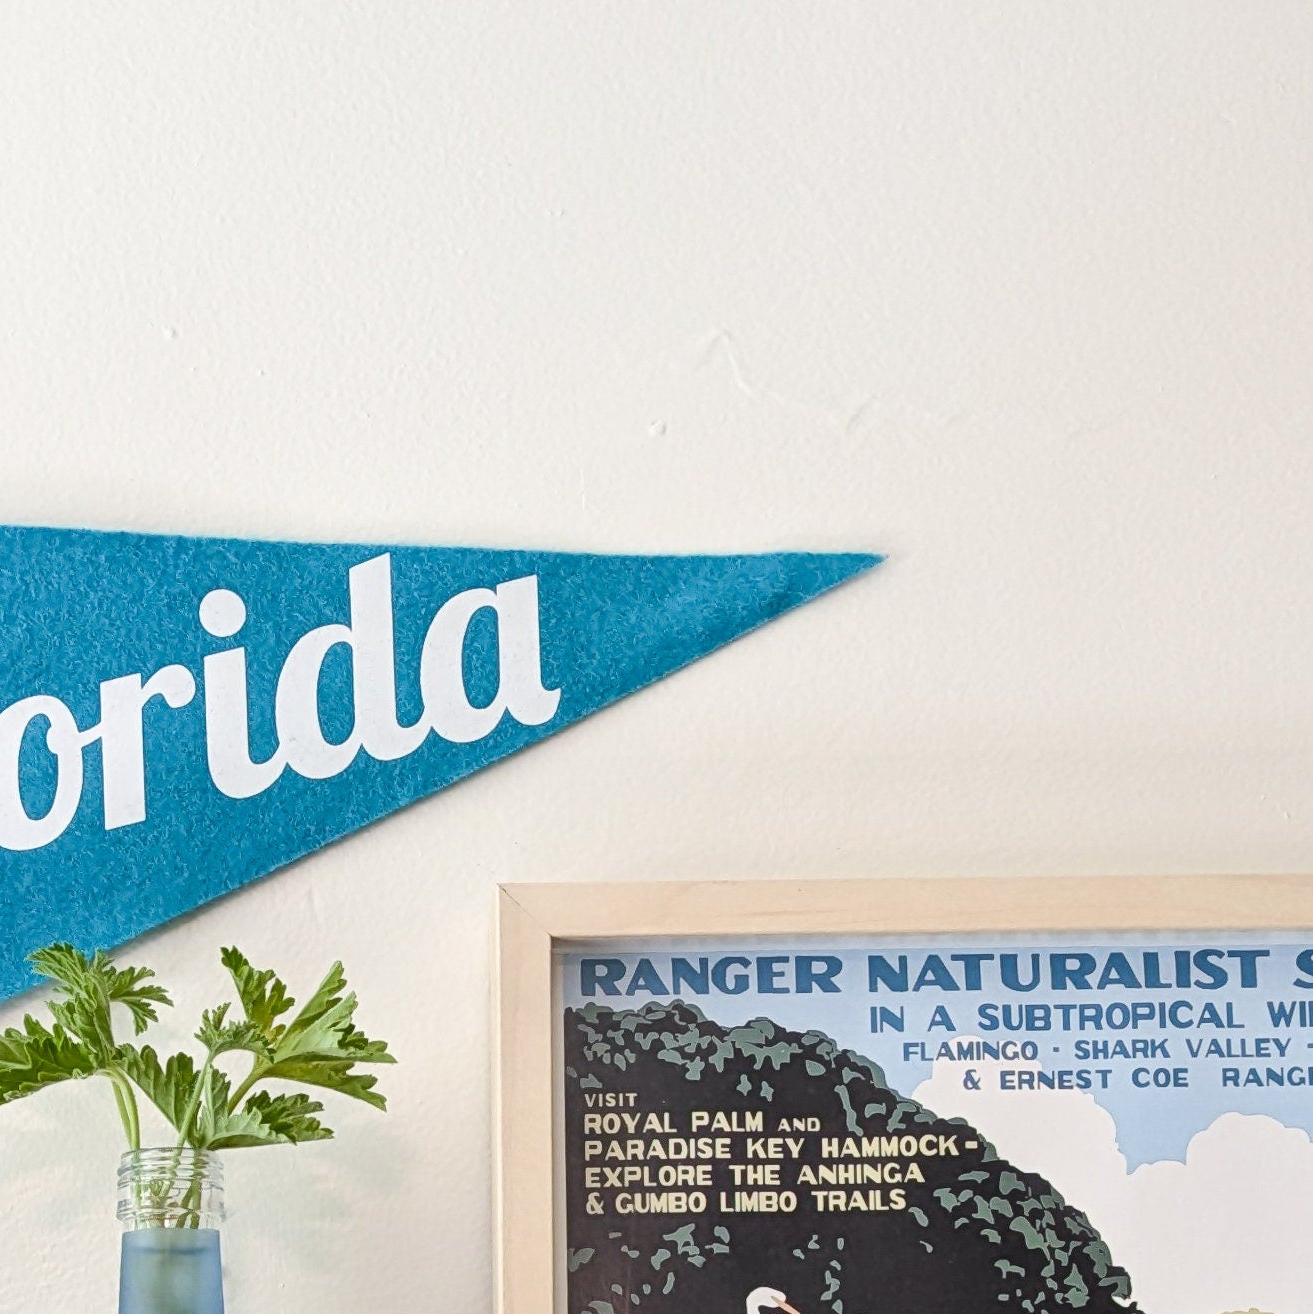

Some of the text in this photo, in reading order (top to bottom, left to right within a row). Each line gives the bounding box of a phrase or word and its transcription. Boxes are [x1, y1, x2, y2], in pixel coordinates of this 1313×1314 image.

[580, 955, 843, 997] RANGER
[867, 948, 1271, 993] NATURALIST
[869, 1005, 905, 1034] IN
[927, 1005, 957, 1033] A
[977, 1000, 1246, 1032] SUBTROPICAL
[903, 1037, 1292, 1062] FLAMINGO SHARK VALLEY
[963, 1066, 1313, 1090] & ERNEST COE RANG
[584, 1092, 638, 1108] VISIT
[584, 1110, 821, 1135] ROYAL PALM AND
[584, 1137, 732, 1162] PARADISE
[746, 1137, 805, 1159] KEY
[585, 1162, 926, 1188] EXPLORE THE ANHINGA
[585, 1188, 907, 1215] & GUMBO LIMBO TRAILS
